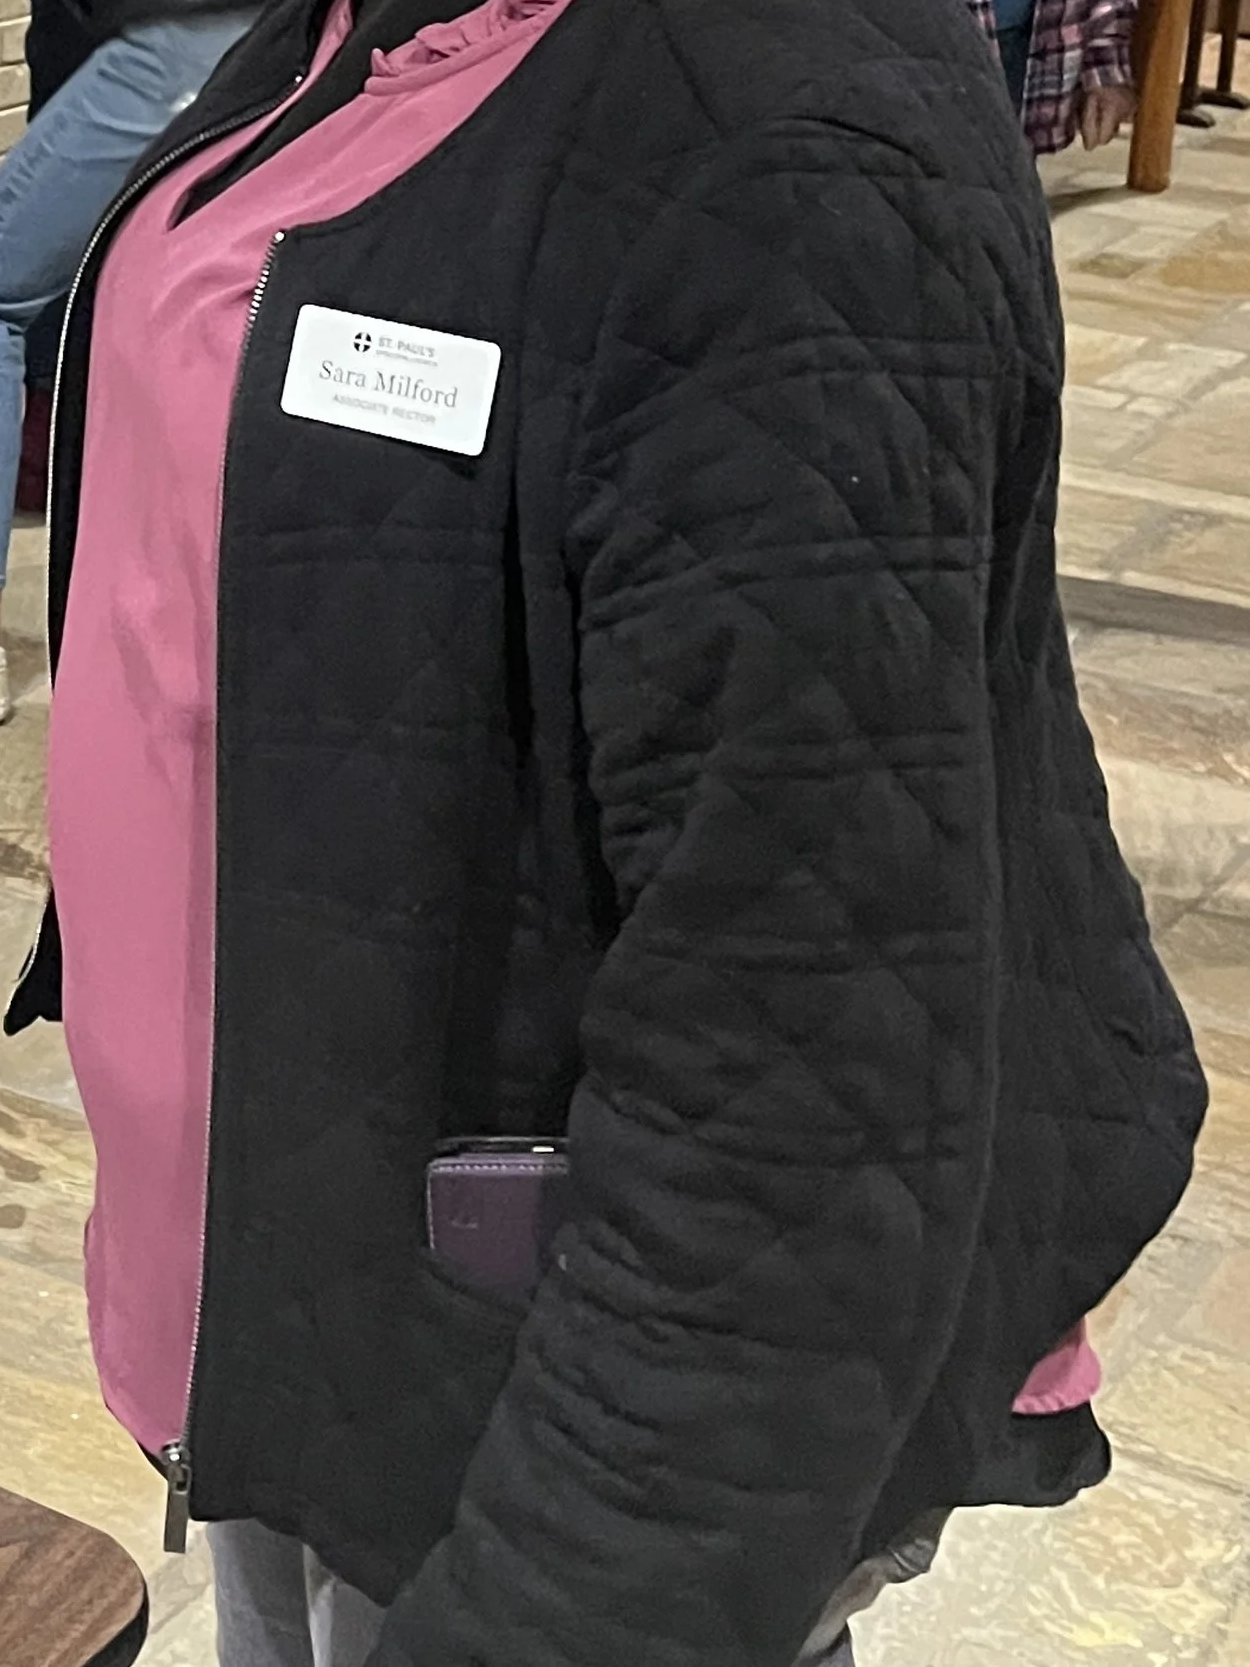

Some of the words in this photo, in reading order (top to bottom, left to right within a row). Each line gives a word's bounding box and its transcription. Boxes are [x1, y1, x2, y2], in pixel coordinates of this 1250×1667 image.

[397, 340, 436, 358] PAUL'S
[319, 360, 366, 388] Sara
[374, 371, 458, 408] Milford
